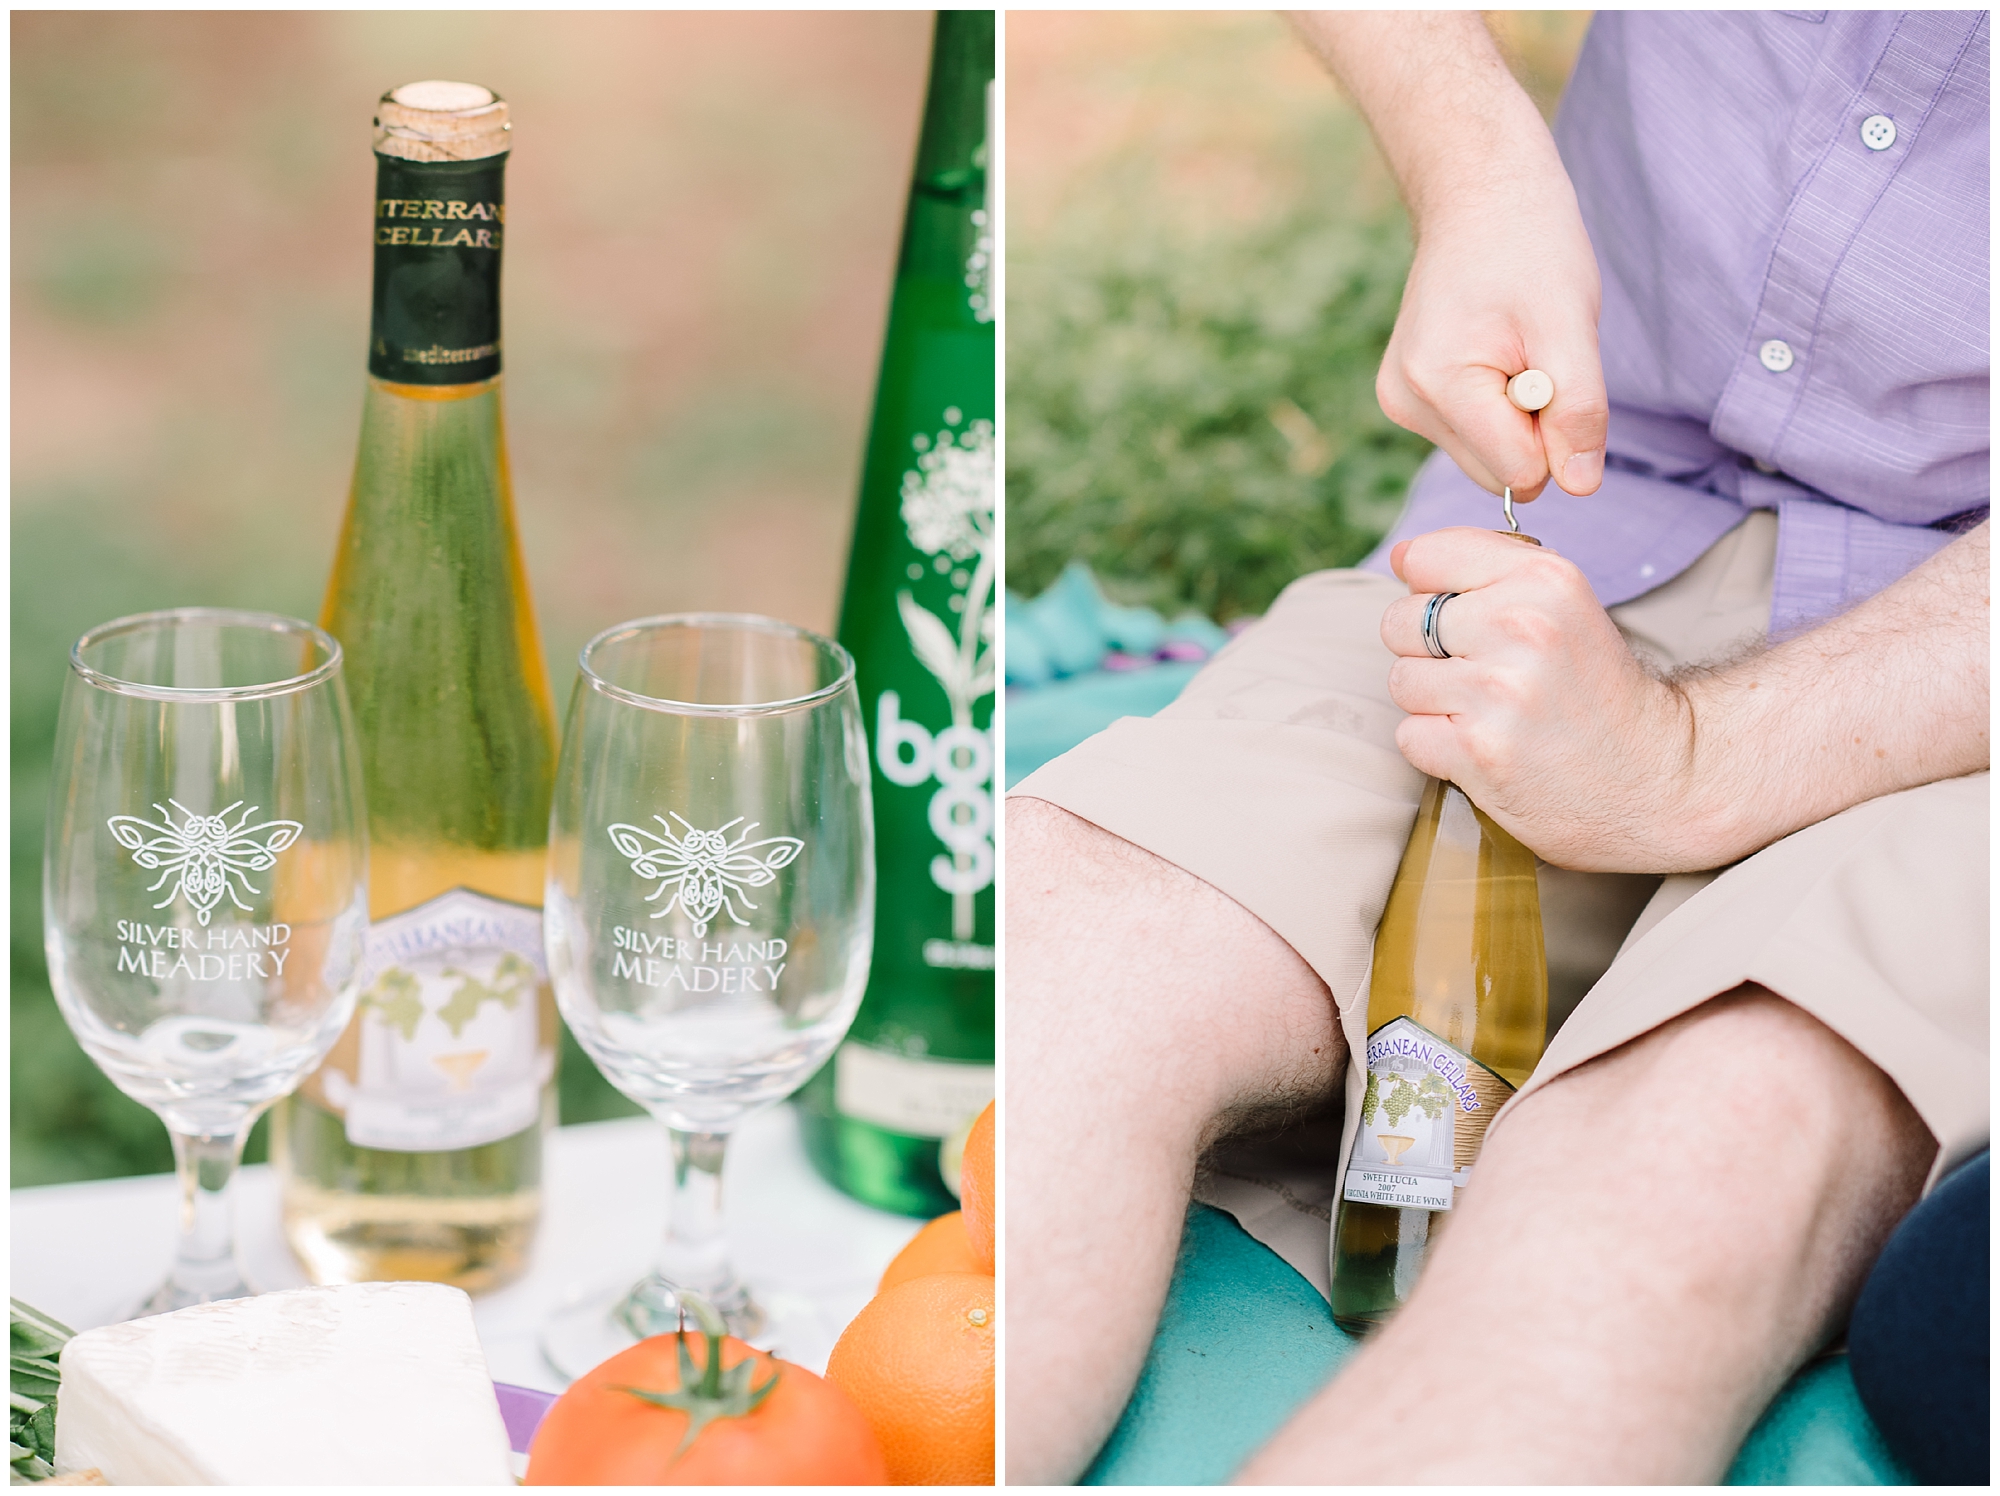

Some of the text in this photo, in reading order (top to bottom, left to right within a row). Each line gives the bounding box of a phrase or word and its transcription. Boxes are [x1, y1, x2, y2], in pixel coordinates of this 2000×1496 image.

[116, 919, 292, 950] SILVER HAND
[613, 925, 788, 963] SILVER HAND
[116, 945, 290, 981] MEADERY
[611, 951, 787, 994] MEADERY
[1367, 1038, 1480, 1112] ERRANEAN CELLARS
[1362, 1172, 1418, 1186] SWEET LUCIA
[1377, 1183, 1397, 1192] 2007
[1370, 1190, 1394, 1202] WHITE
[1395, 1193, 1421, 1204] TABLE
[1423, 1196, 1448, 1207] WINE
